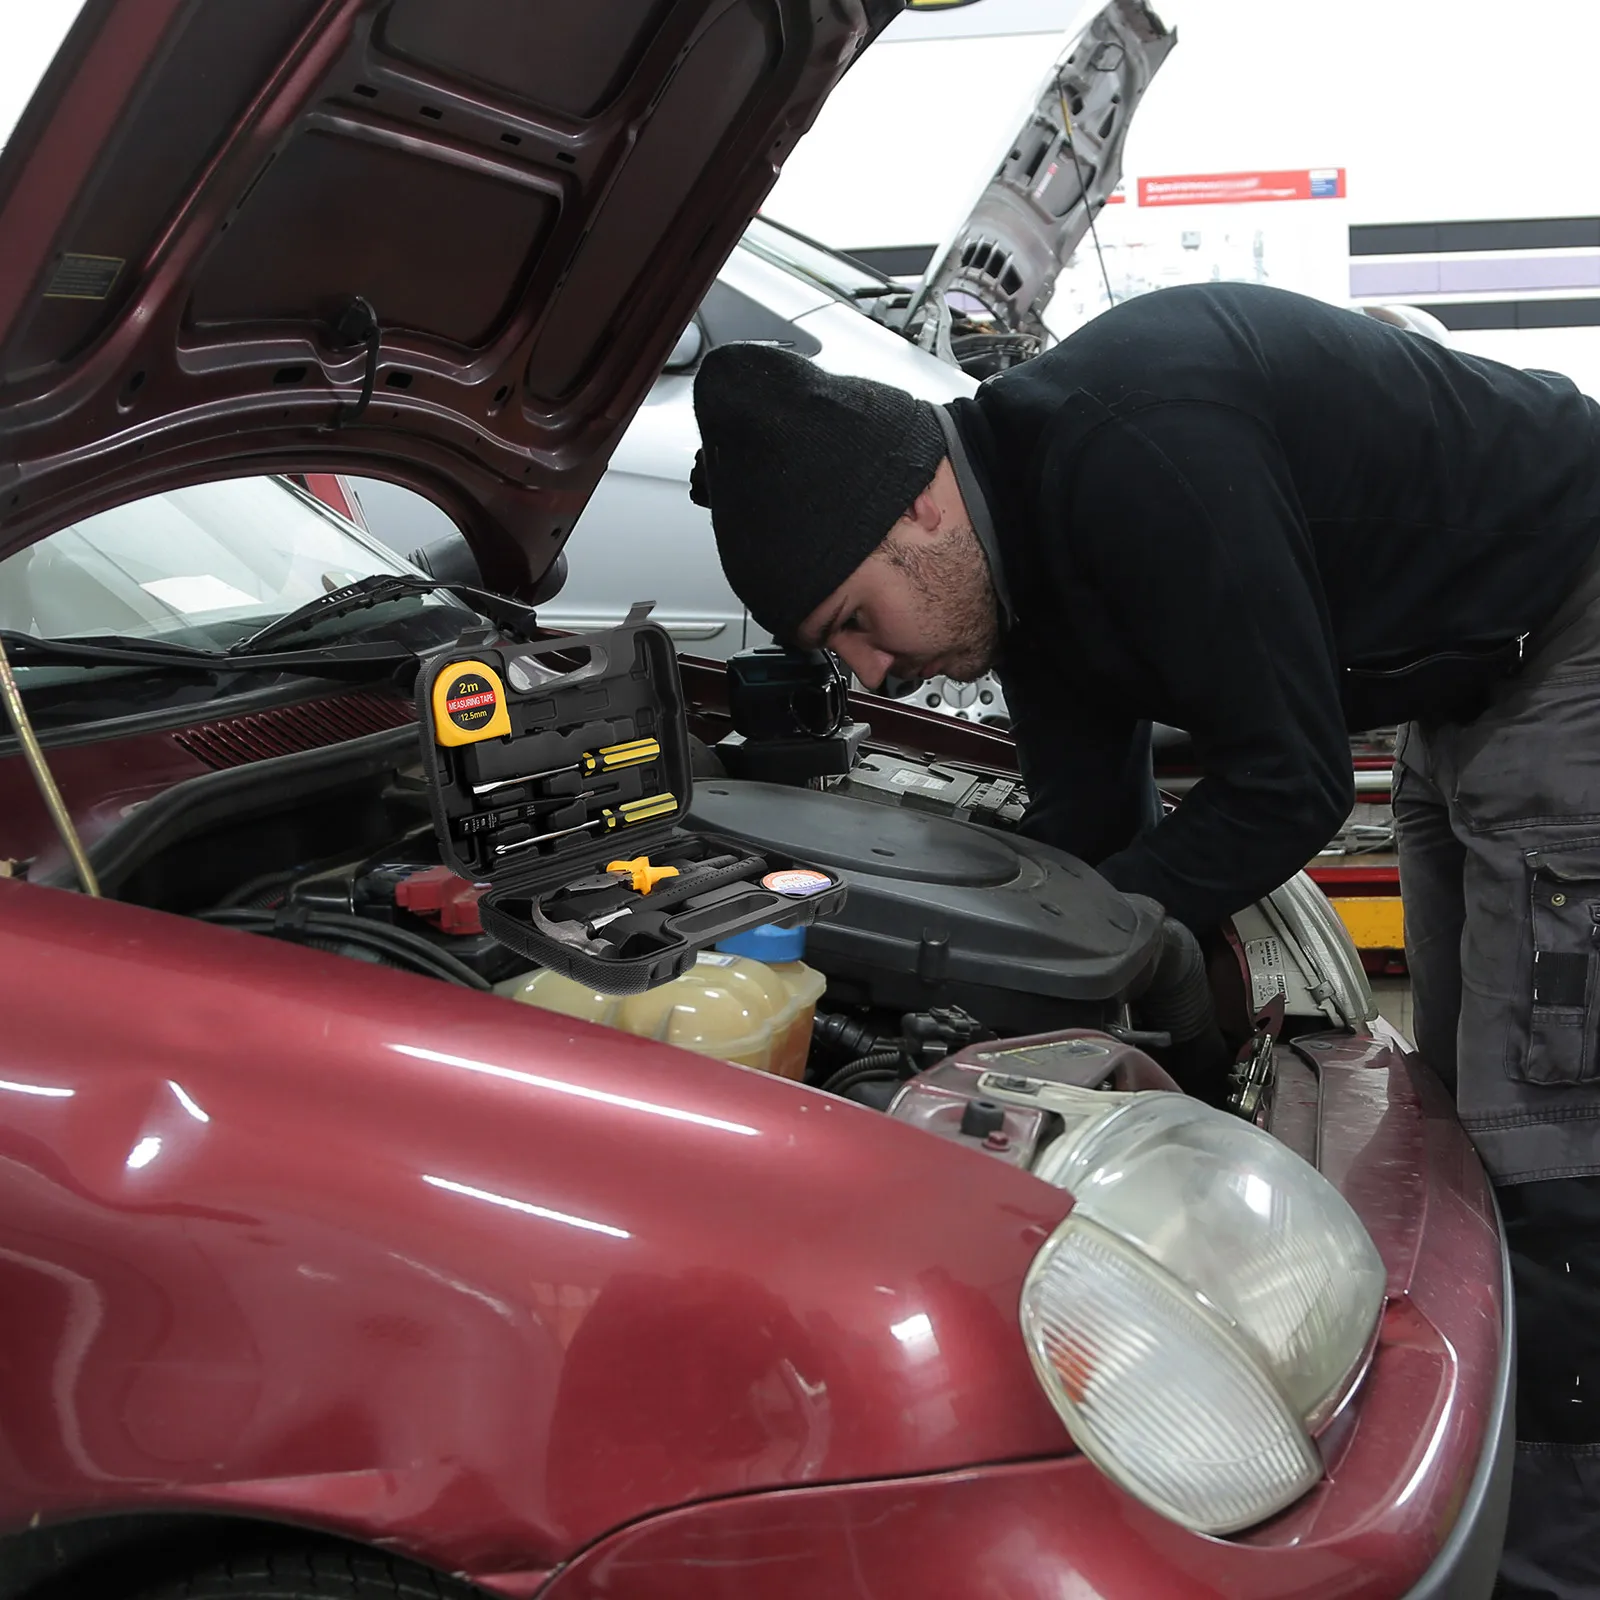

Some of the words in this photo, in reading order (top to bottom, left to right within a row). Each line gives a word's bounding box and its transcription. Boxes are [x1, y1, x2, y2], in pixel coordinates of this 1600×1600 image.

[459, 682, 479, 694] 2m
[448, 696, 481, 711] MEASURING
[480, 693, 494, 704] TAPE
[460, 710, 488, 721] 12.5mm
